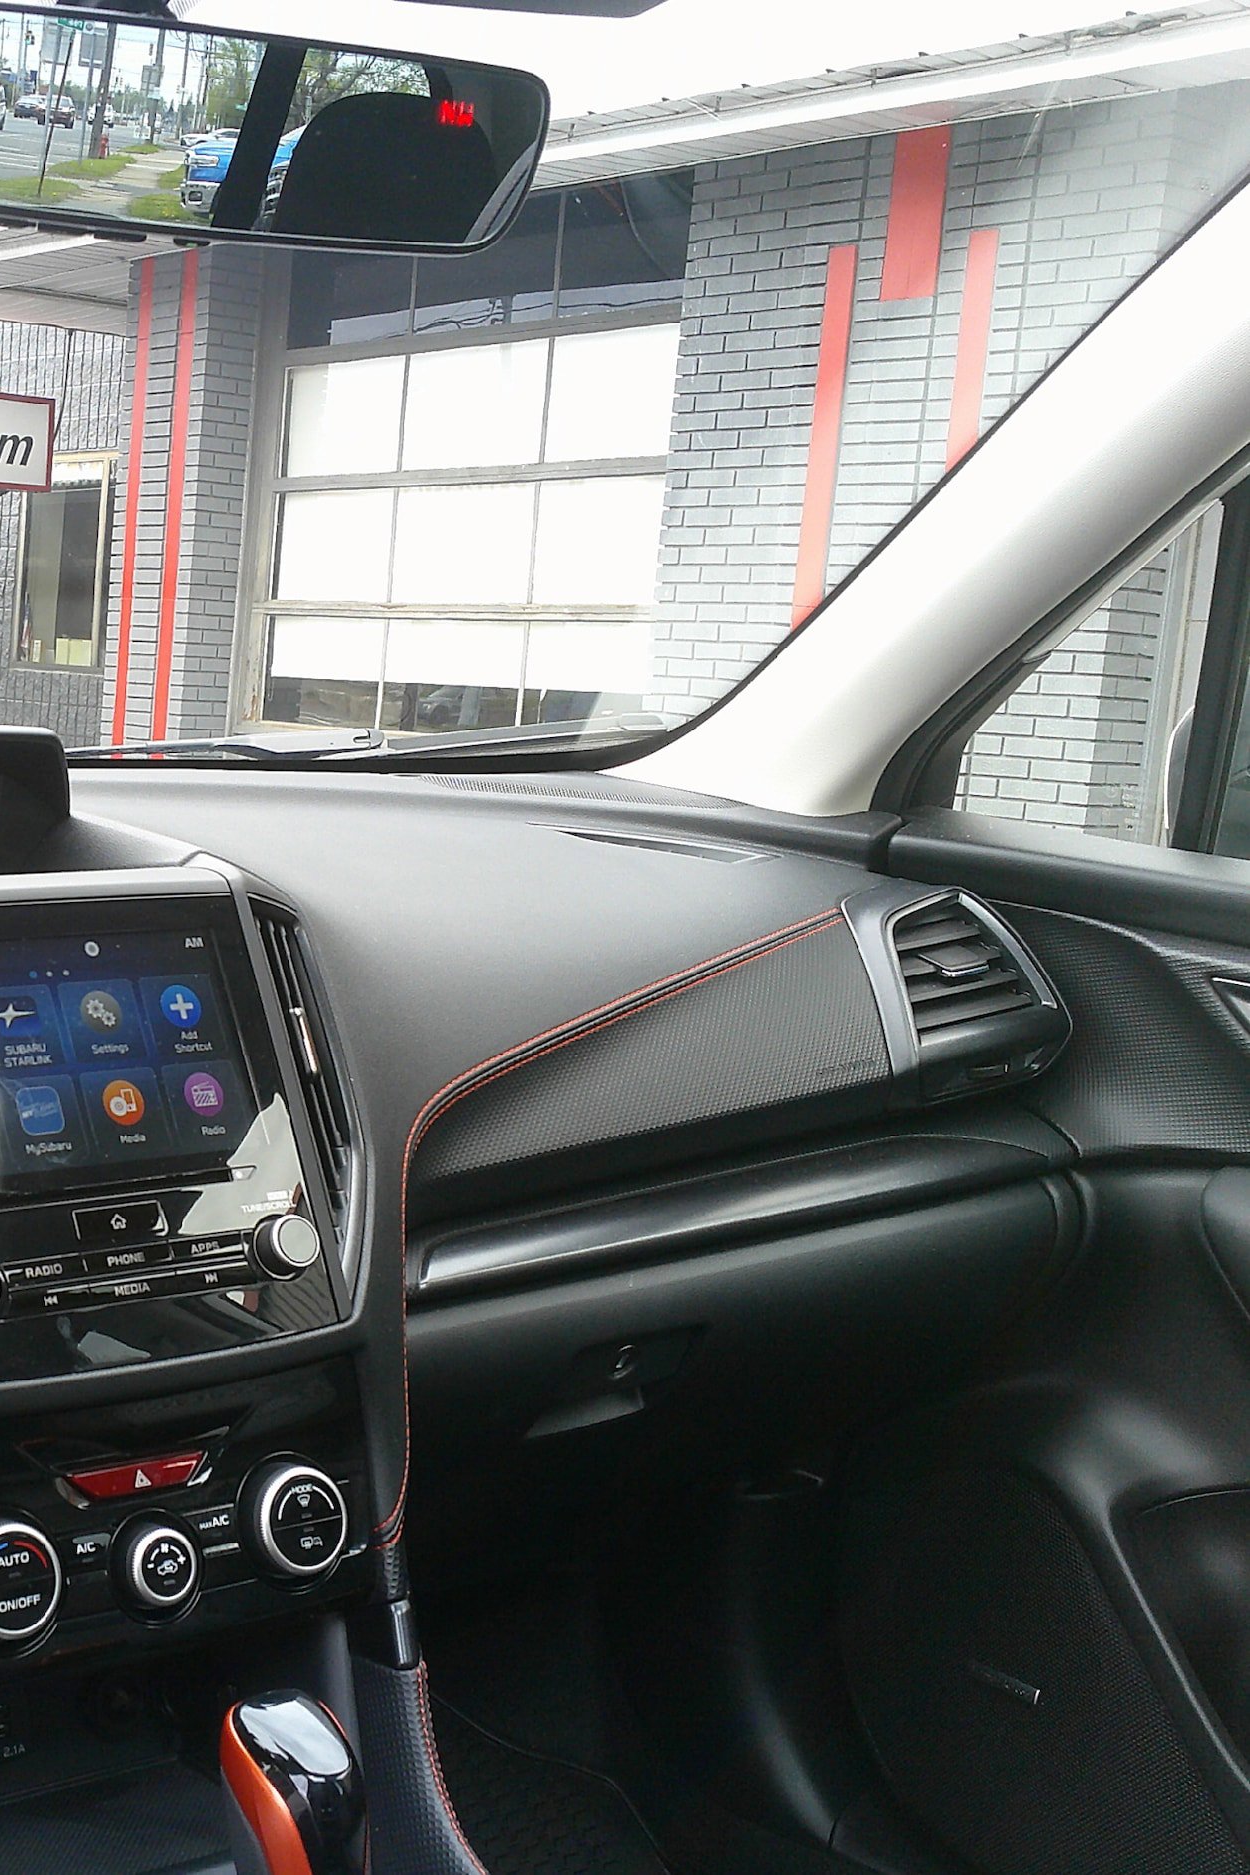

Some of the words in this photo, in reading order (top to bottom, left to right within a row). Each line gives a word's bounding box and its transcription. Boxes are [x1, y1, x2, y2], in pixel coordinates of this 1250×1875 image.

[185, 937, 204, 949] AM
[181, 1031, 198, 1041] Add
[5, 1044, 47, 1055] SUBARU
[91, 1044, 129, 1056] Settings
[174, 1042, 213, 1053] Shortcut
[4, 1054, 52, 1067] STARLINK
[201, 1125, 226, 1137] Radio
[120, 1133, 146, 1144] Media
[25, 1141, 72, 1155] MySubaru
[191, 1241, 220, 1254] APPS
[107, 1252, 145, 1267] PHONE
[25, 1264, 63, 1278] RADIO
[114, 1282, 150, 1296] MEDIA
[291, 1484, 313, 1494] MODE
[212, 1514, 230, 1527] A/C
[76, 1541, 96, 1555] A/C
